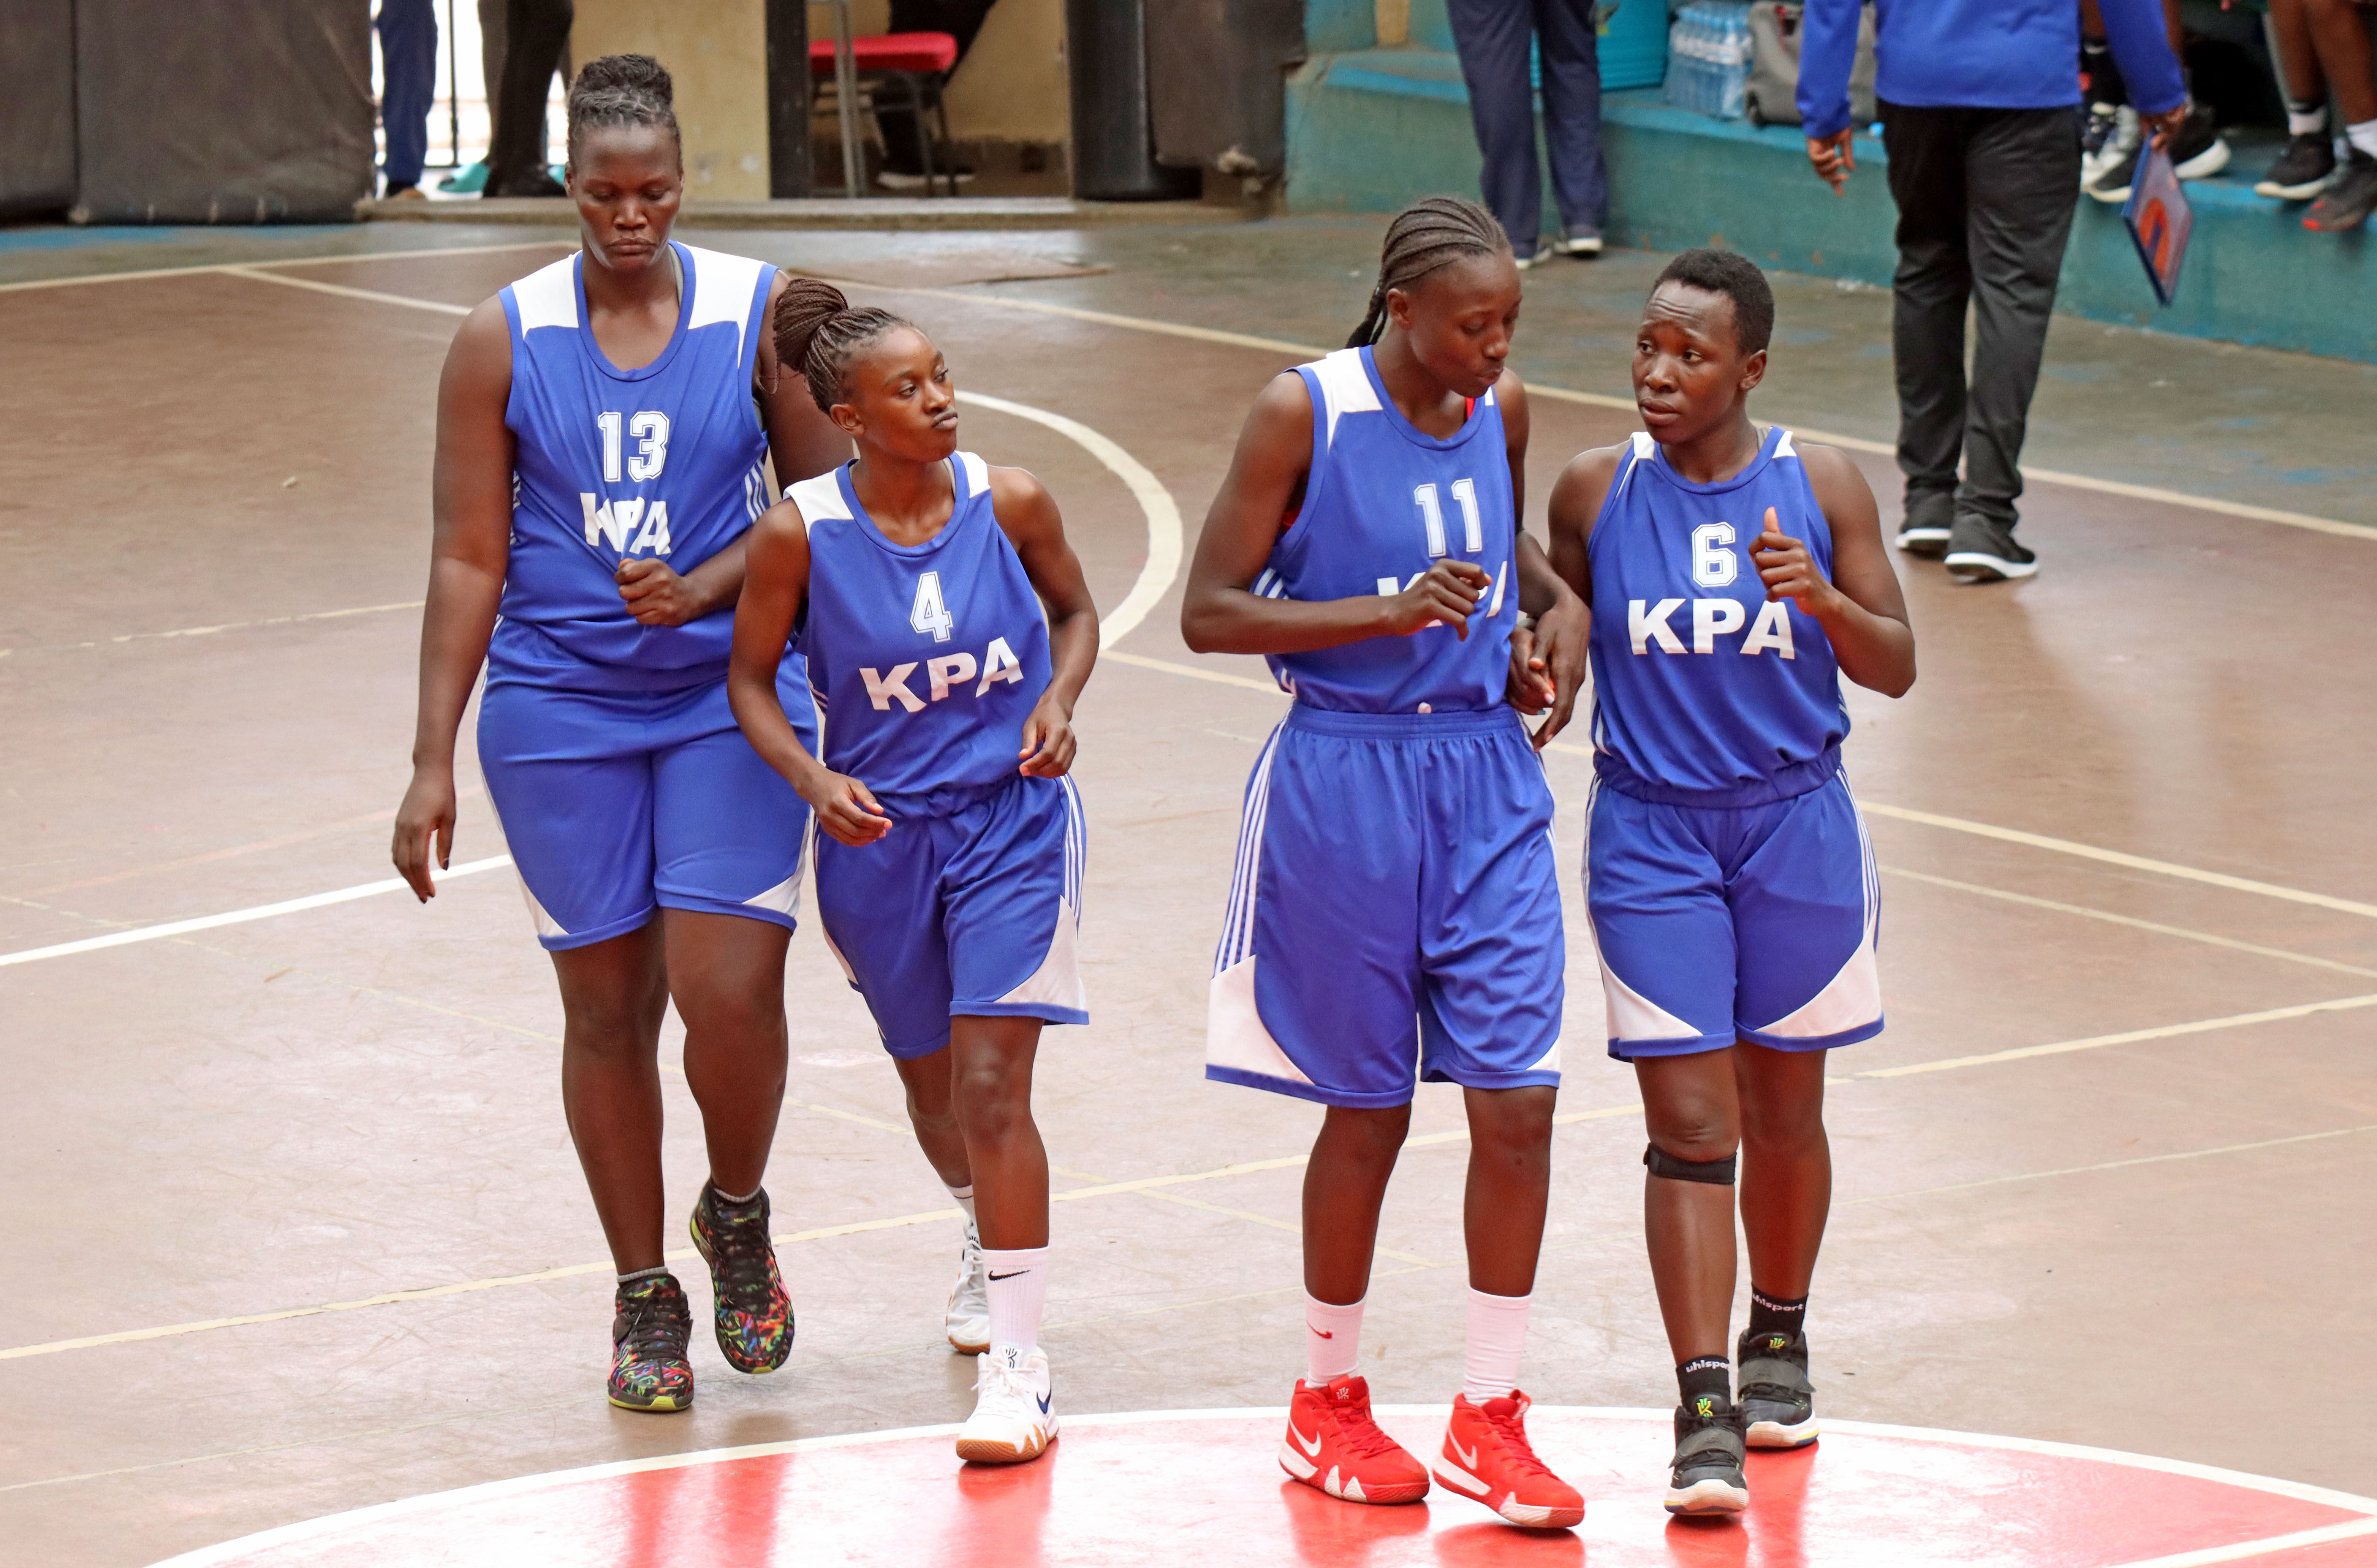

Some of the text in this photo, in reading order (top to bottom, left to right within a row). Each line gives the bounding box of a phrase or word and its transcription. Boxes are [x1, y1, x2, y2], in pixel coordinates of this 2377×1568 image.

[597, 410, 671, 483] 13
[579, 492, 672, 556] KPA
[1413, 477, 1484, 558] 11
[1691, 521, 1739, 589] 6
[908, 571, 955, 644] 4
[1628, 597, 1795, 660] KPA
[859, 636, 1024, 713] KPA
[1685, 1359, 1729, 1373] uhlspor
